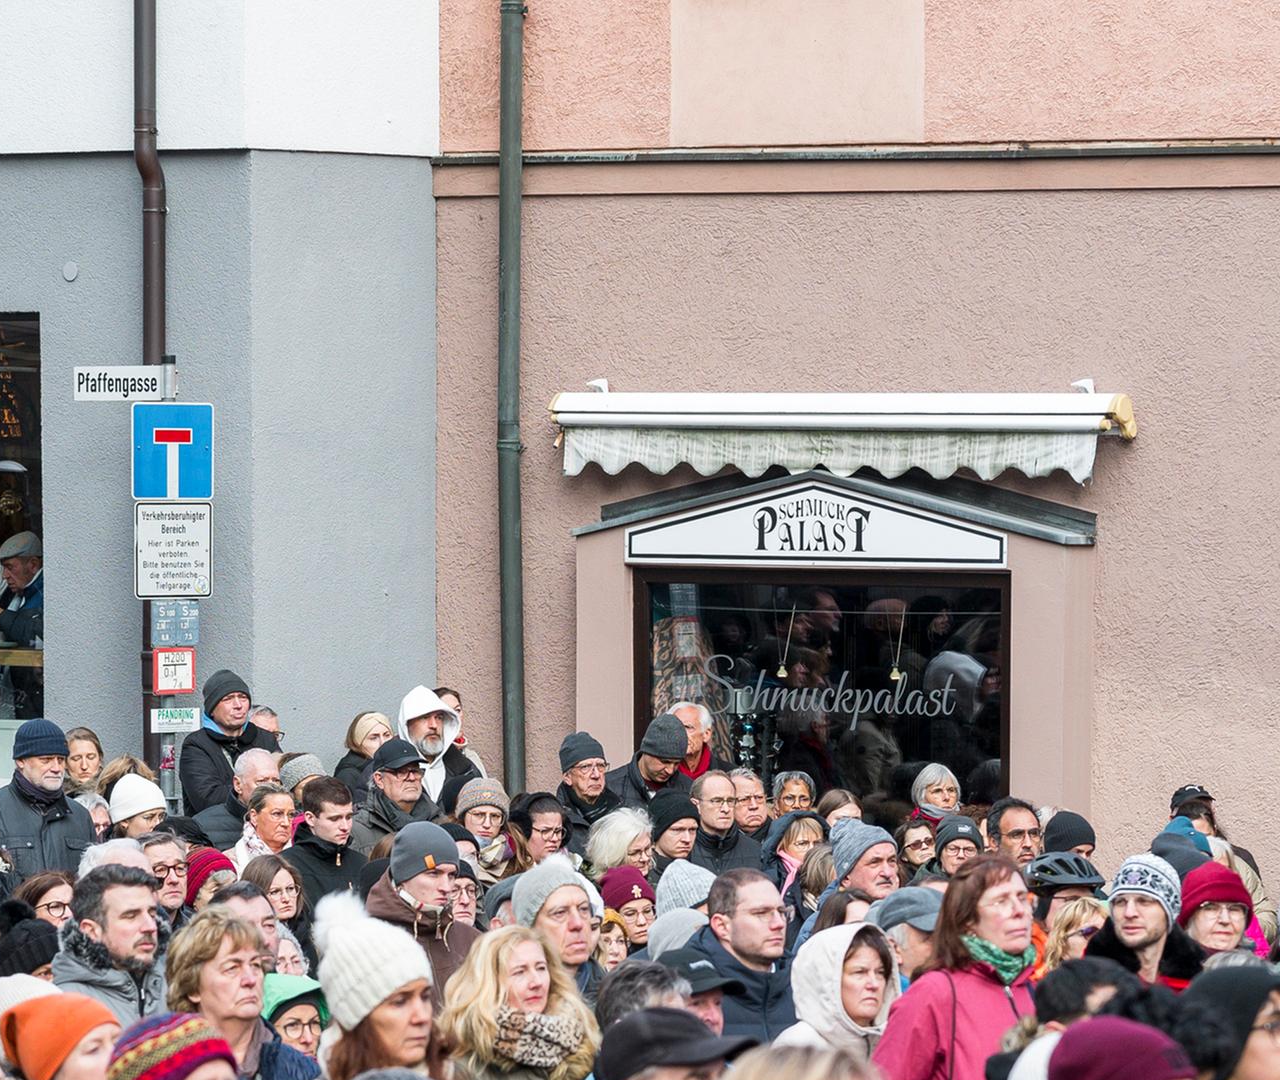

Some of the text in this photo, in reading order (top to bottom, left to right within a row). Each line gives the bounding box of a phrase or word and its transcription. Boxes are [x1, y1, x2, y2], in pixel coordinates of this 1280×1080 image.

[77, 372, 158, 398] Pfaffengasse
[779, 498, 845, 520] SCHMUCK
[141, 510, 206, 523] Verkehrsberuhigter
[161, 524, 186, 534] Bereich
[753, 506, 871, 553] PALAST
[176, 539, 199, 547] Parken
[143, 560, 204, 569] Bitte benutzen Sie
[149, 571, 160, 579] die
[701, 653, 957, 731] Schmuckpalast
